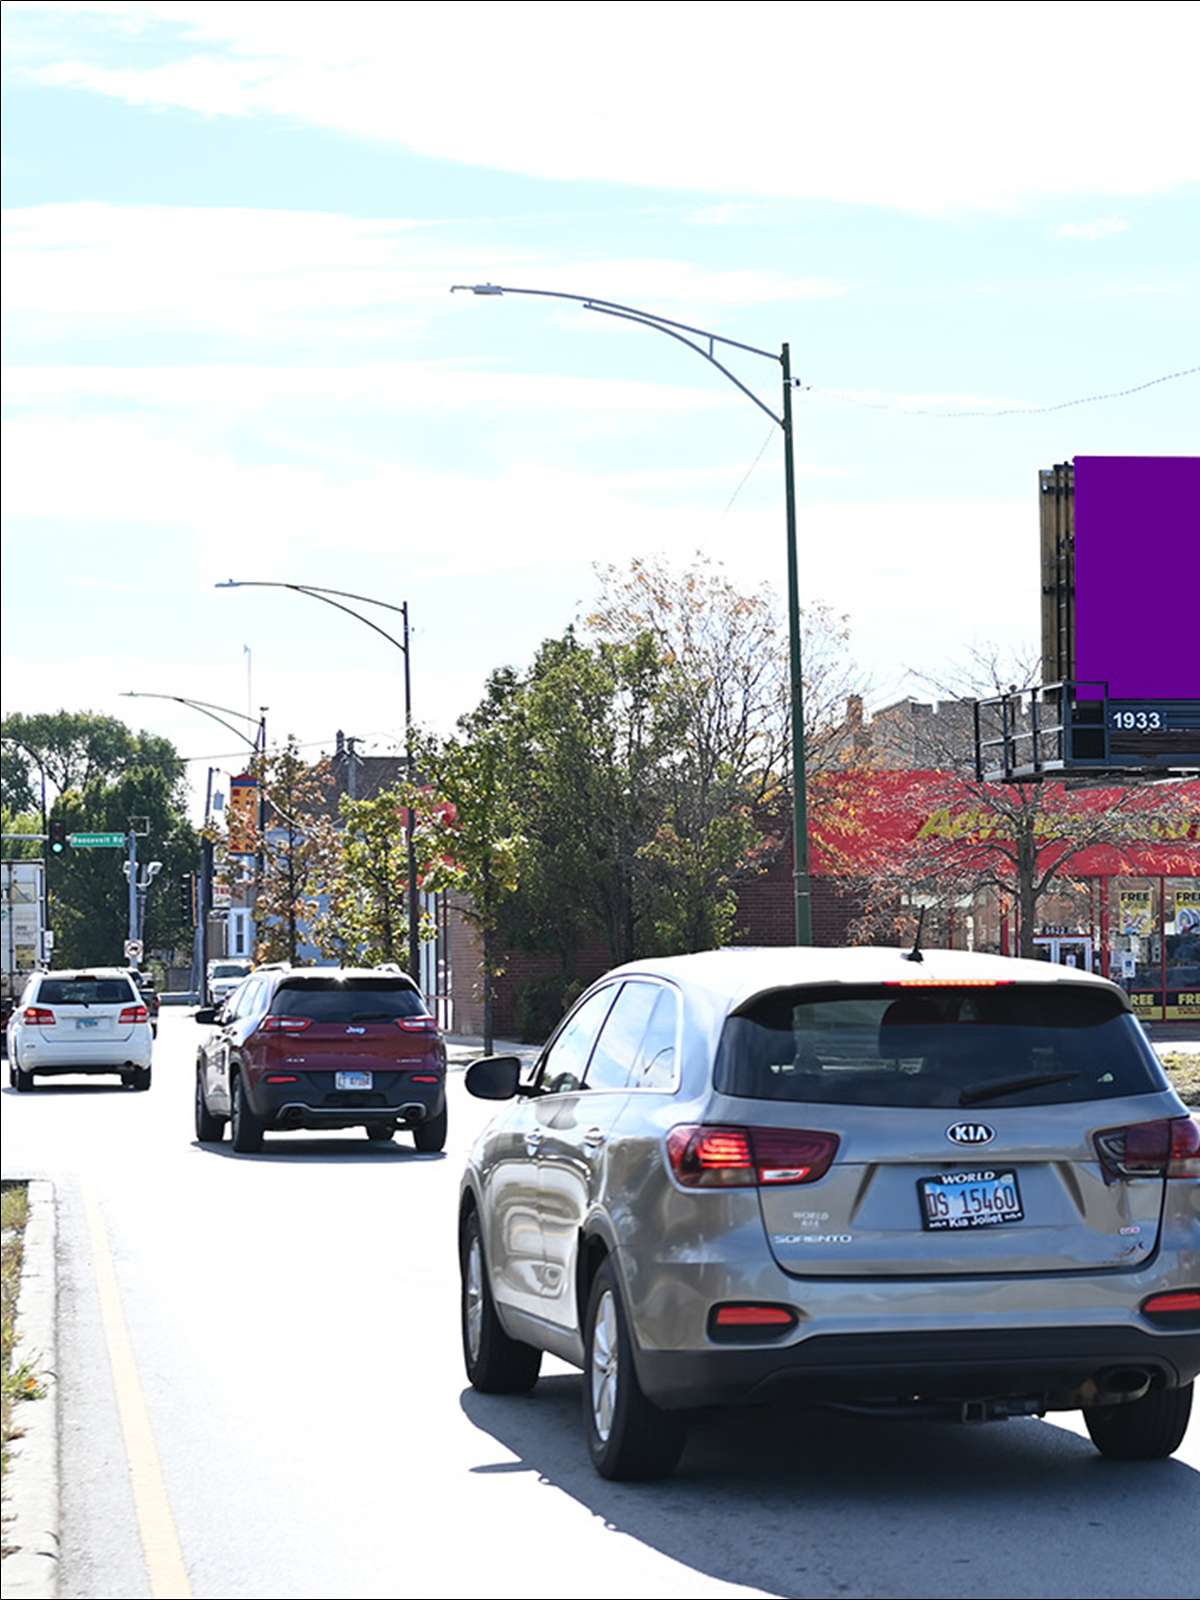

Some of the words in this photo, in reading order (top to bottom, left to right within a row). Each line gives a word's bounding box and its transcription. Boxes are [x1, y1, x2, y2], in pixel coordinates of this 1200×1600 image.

[1112, 711, 1161, 730] 1933
[72, 835, 111, 844] Roosevelt
[1120, 891, 1150, 901] FREE
[1131, 993, 1155, 1006] REE
[346, 1026, 367, 1034] Jeep
[955, 1125, 988, 1141] KIA
[941, 1170, 996, 1185] WORLD
[926, 1191, 950, 1218] DS
[960, 1185, 1017, 1215] 15460
[948, 1215, 969, 1228] Kia
[970, 1213, 1004, 1227] Joliet
[774, 1234, 852, 1244] SORENTO
